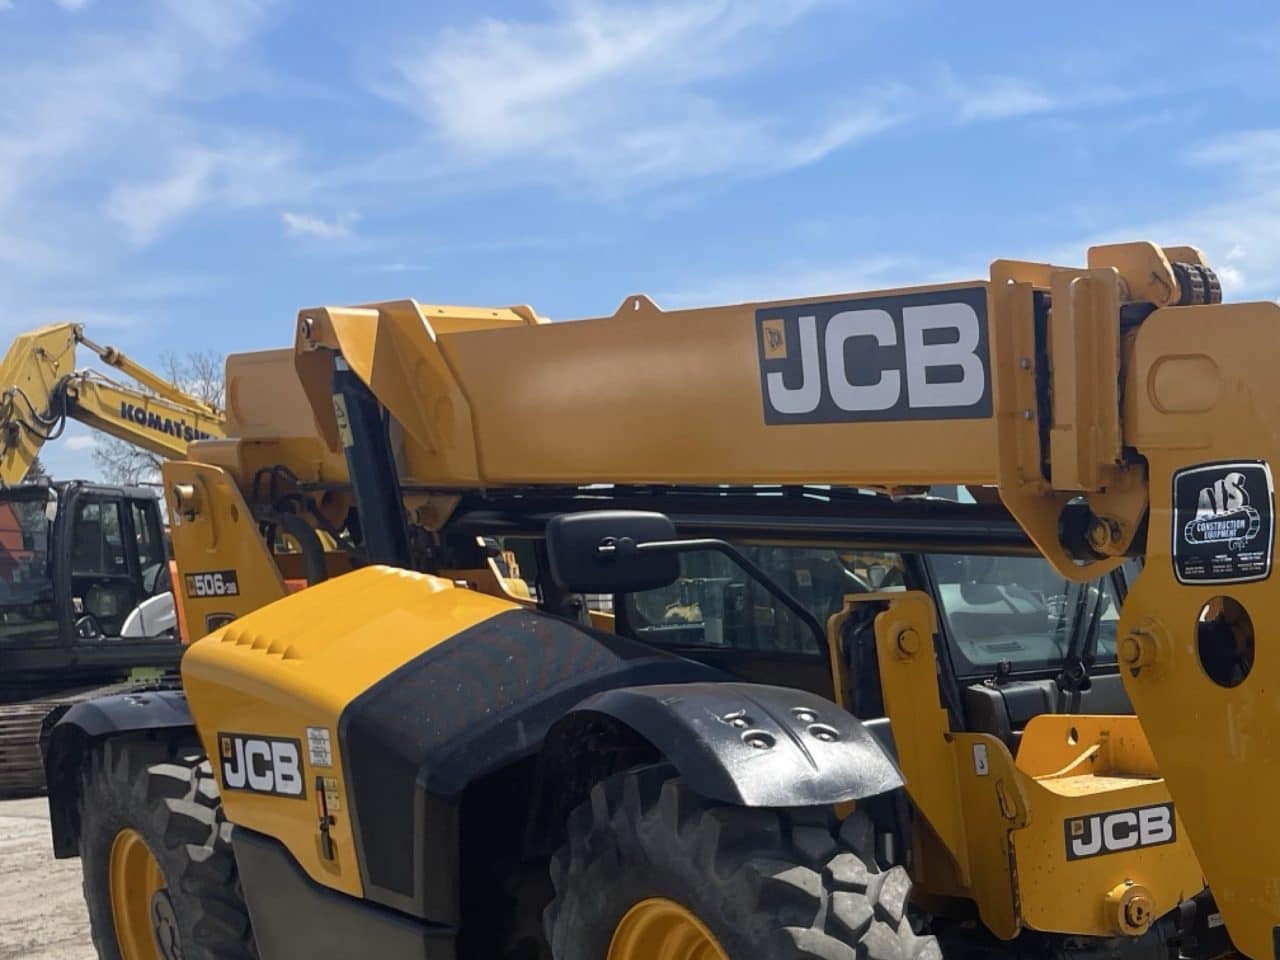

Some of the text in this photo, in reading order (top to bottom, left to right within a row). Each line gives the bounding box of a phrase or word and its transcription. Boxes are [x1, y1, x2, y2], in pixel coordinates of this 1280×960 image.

[767, 302, 985, 414] JCB
[1196, 519, 1246, 532] CONSTRUCTION
[1203, 529, 1237, 540] EQUIPMENT
[223, 738, 303, 795] JCB
[1071, 805, 1174, 857] JCB
